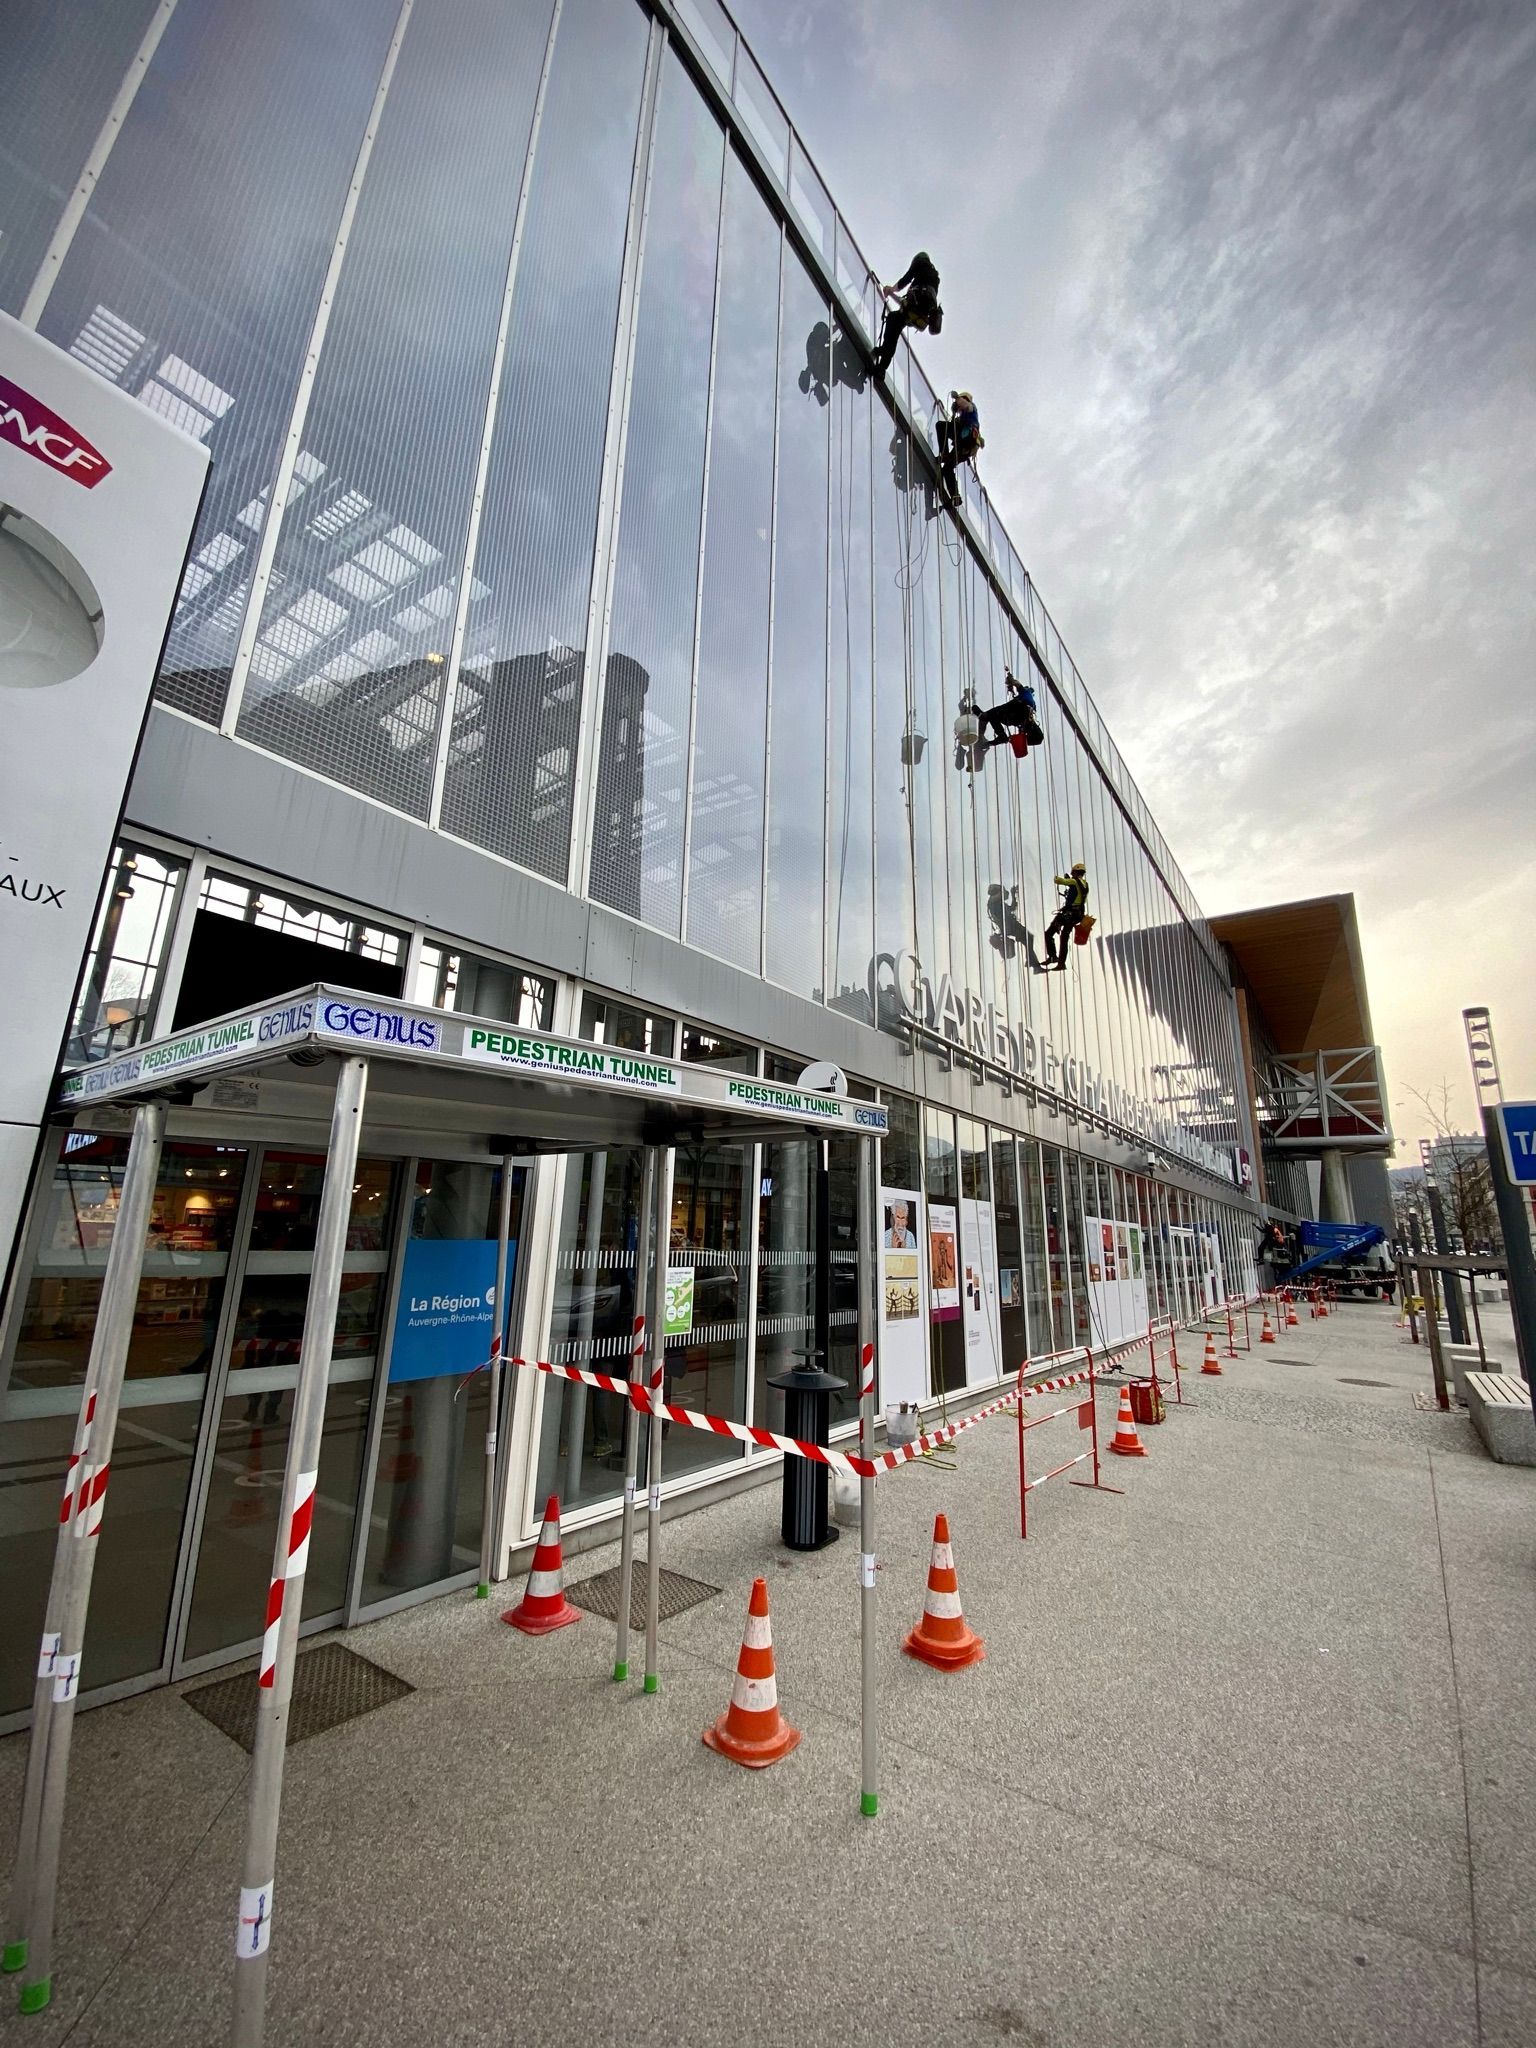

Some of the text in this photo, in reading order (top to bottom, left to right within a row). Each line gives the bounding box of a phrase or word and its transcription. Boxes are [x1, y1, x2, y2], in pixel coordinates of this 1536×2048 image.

[0, 399, 103, 470] NCF
[259, 1002, 313, 1041] GENIUS
[324, 1003, 435, 1048] GENIUS
[894, 949, 1007, 1064] GARE
[1018, 1021, 1057, 1089] DE
[143, 1020, 254, 1070] PEDESTRIAN TUNNEL
[471, 1030, 676, 1085] PEDESTRIAN TUNNEL
[501, 1055, 657, 1088] www.geniuspedestriantunnel.com
[729, 1082, 843, 1116] PEDESTRIAN TUNNEL
[854, 1108, 886, 1129] GENIUS
[1513, 1131, 1536, 1155] T
[408, 1312, 494, 1327] Auvergne-Rhône-Alpe
[410, 1294, 480, 1312] La Région
